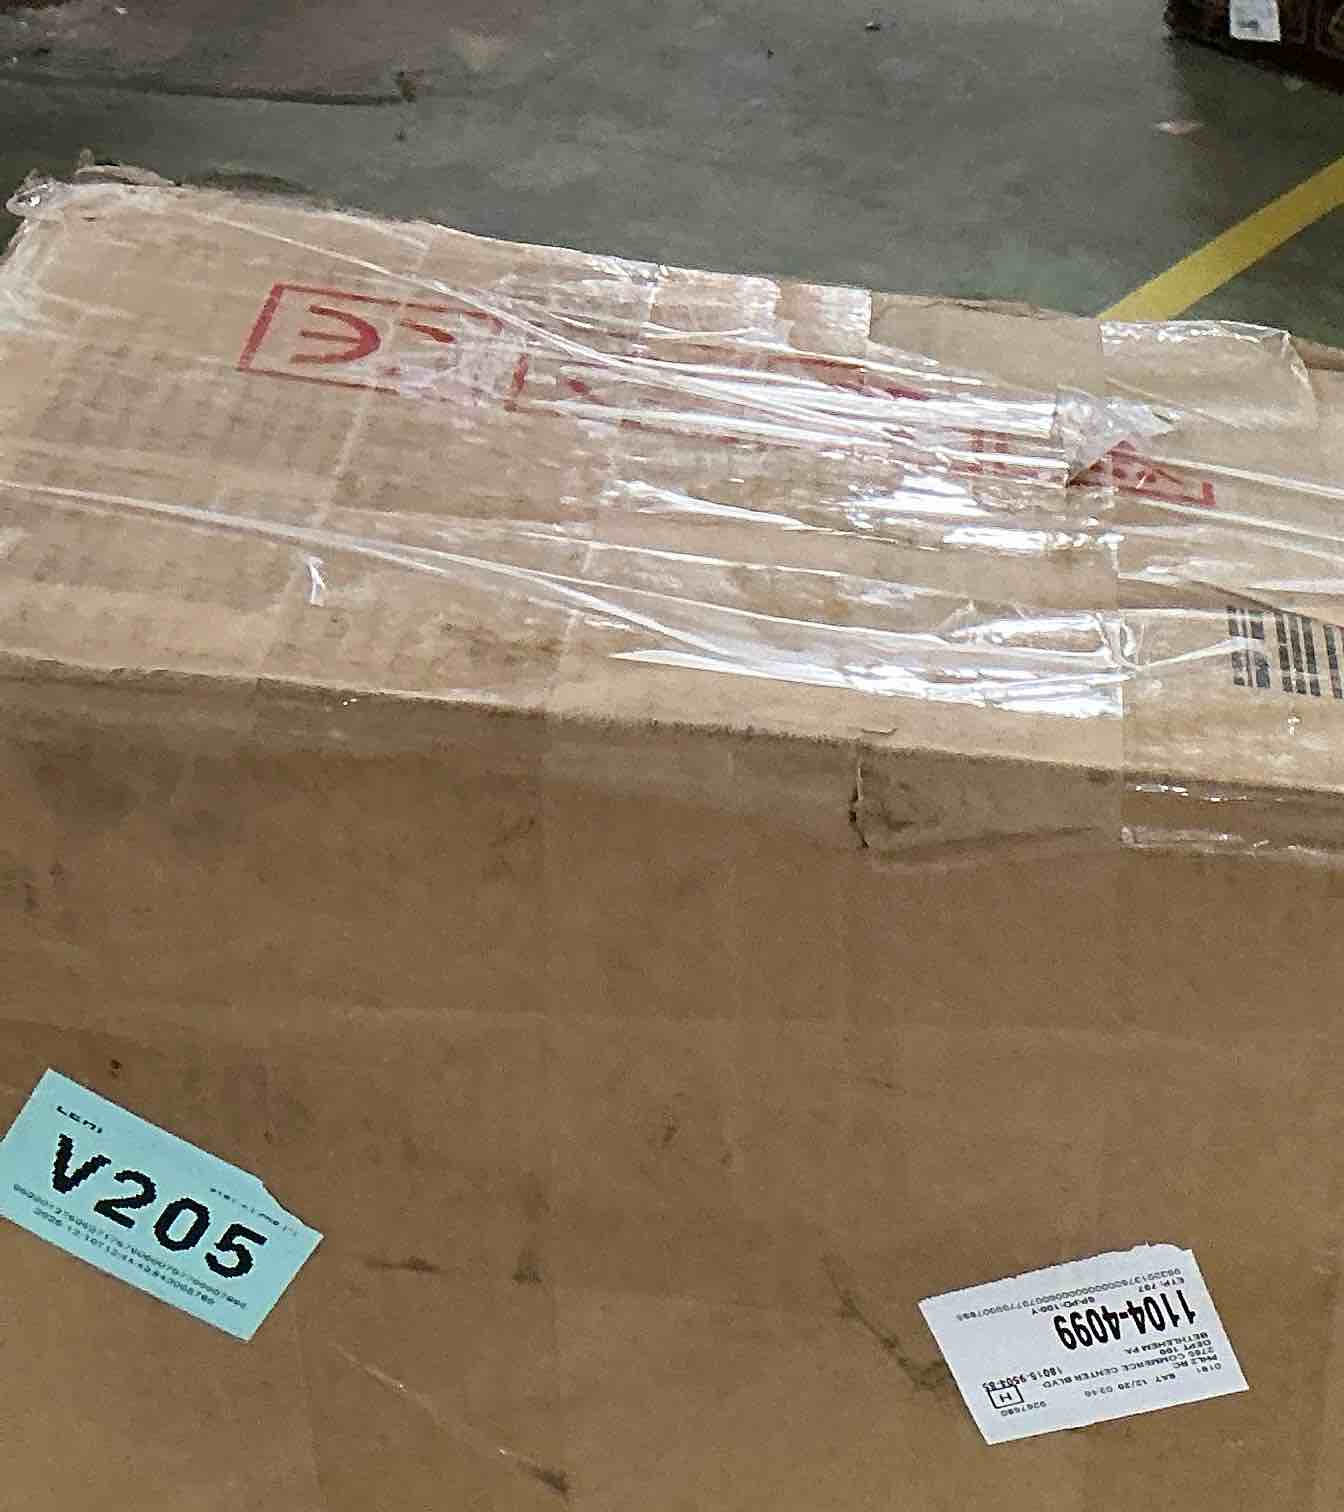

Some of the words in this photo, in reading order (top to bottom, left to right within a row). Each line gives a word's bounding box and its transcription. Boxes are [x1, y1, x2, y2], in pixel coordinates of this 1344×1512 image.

[51, 1132, 269, 1279] V205
[1053, 1289, 1196, 1350] 1104-4099
[1141, 1331, 1209, 1353] BETHLEHEM
[1121, 1352, 1186, 1372] COMMERCE
[1073, 1366, 1120, 1381] CENTER
